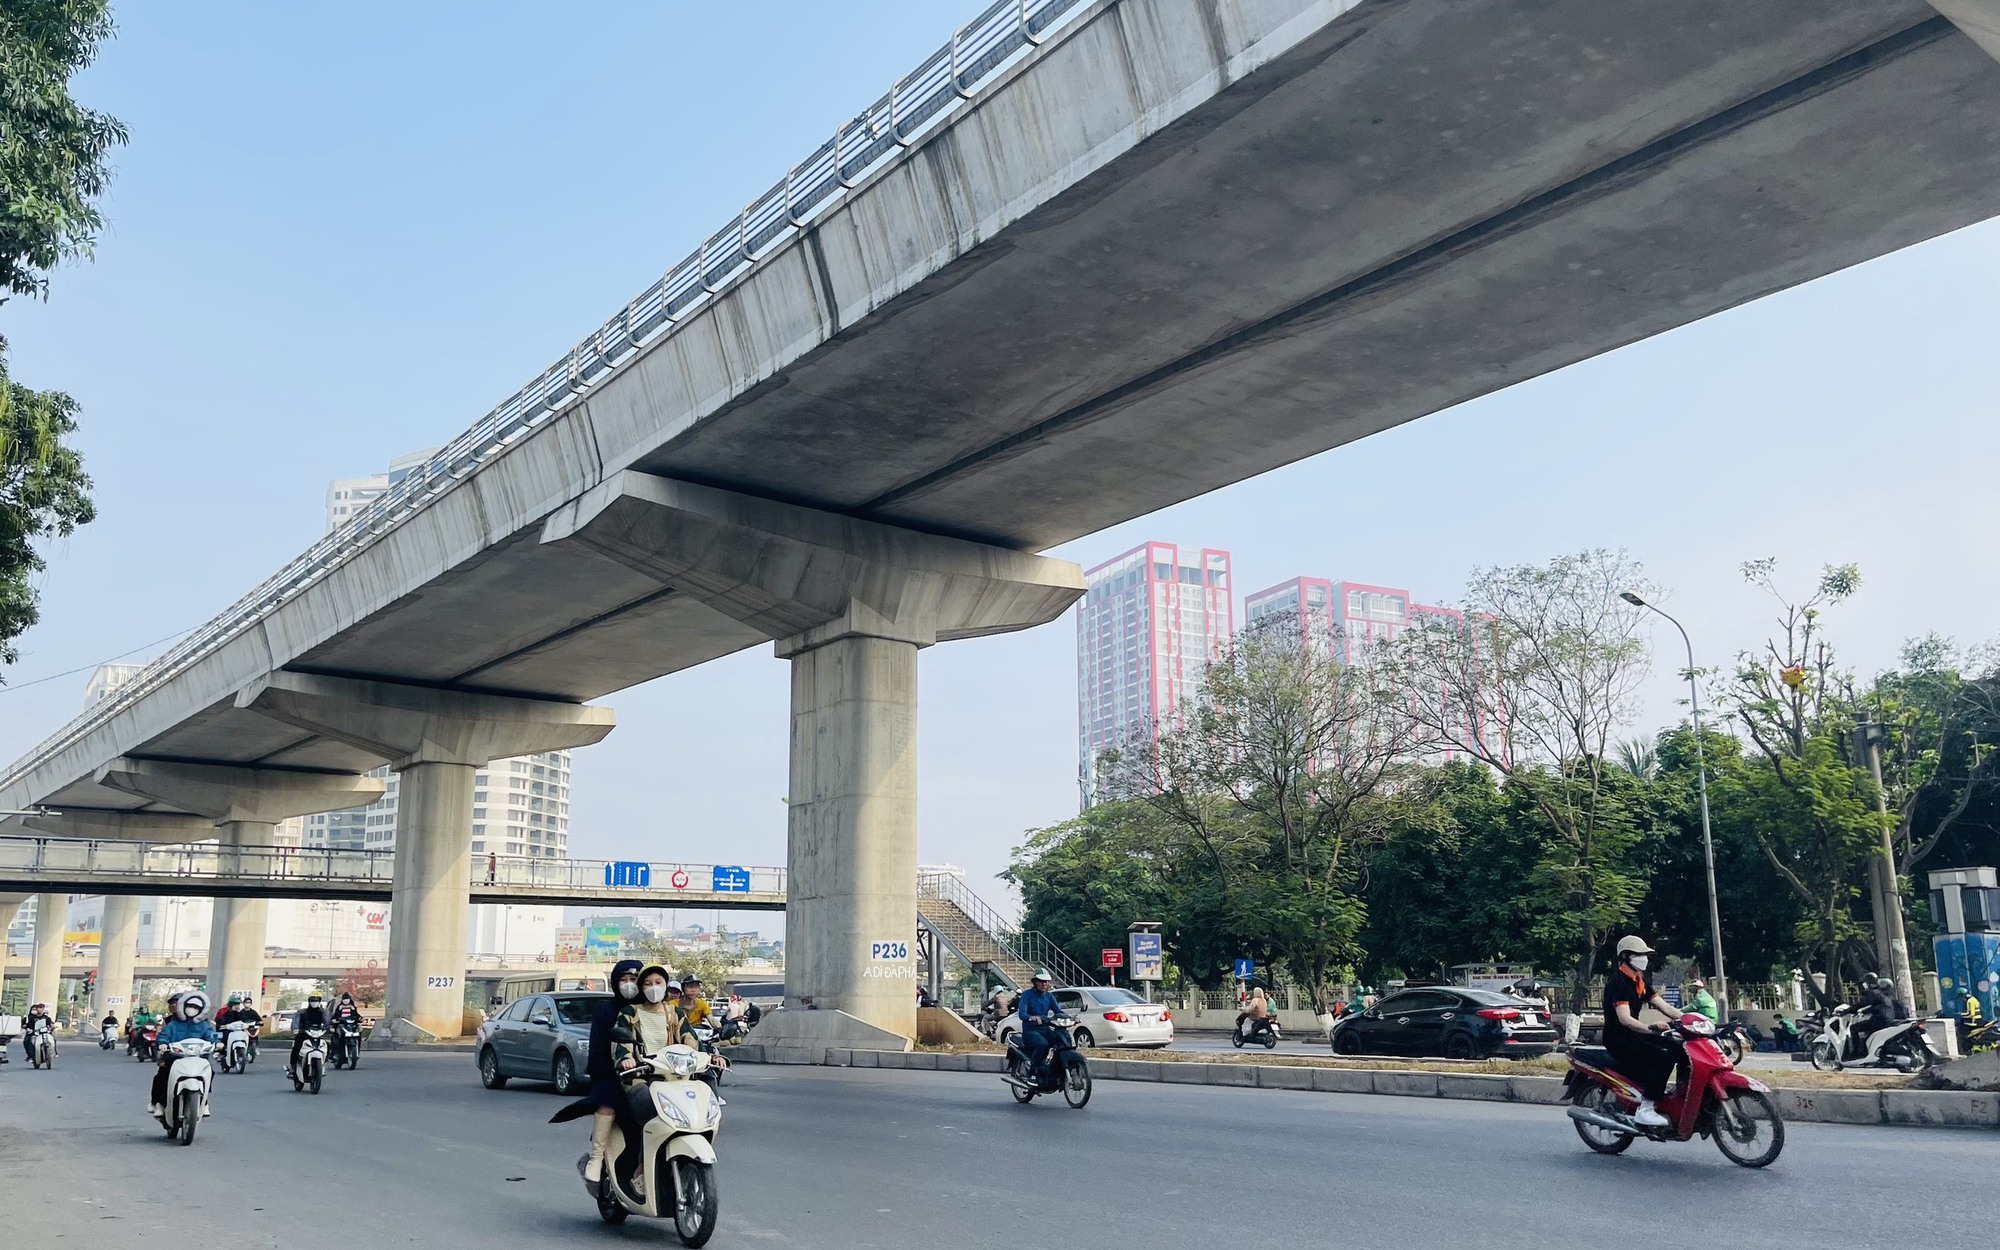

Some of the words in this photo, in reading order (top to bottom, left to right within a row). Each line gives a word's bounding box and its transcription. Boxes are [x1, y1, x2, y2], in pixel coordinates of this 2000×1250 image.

[367, 912, 385, 923] CGV
[873, 943, 907, 959] P236
[428, 977, 454, 987] P237
